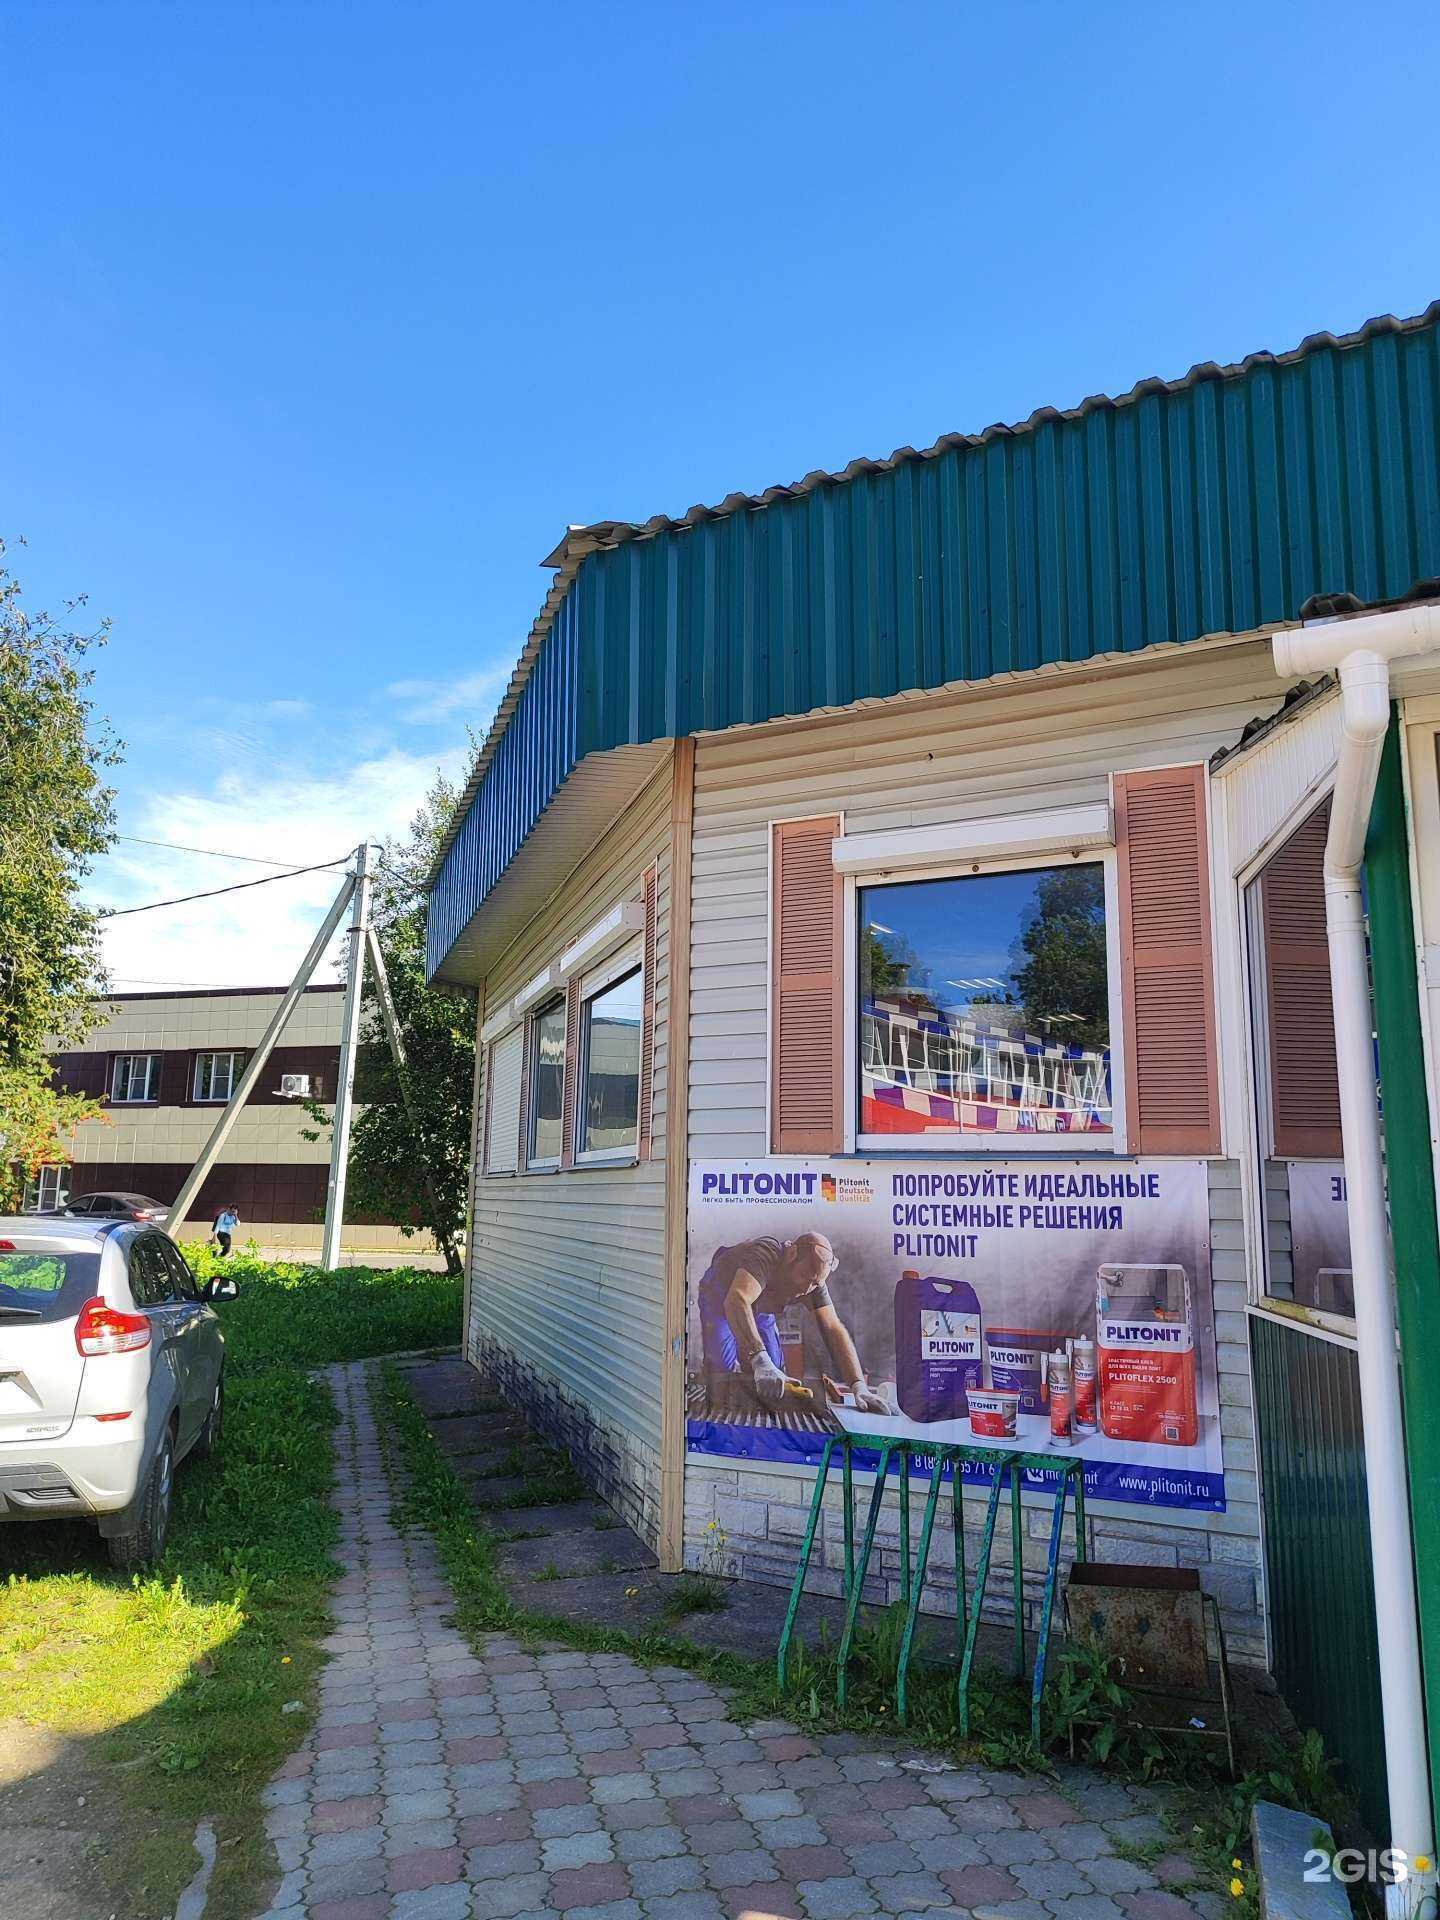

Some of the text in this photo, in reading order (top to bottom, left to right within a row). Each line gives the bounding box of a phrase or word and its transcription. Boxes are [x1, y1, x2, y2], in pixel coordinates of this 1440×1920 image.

[702, 1173, 817, 1195] PLITONIT
[839, 1178, 870, 1186] Plitonit
[892, 1169, 1160, 1201] ПОПРОБУЙТЕ ИДЕАЛЬНЫЕ
[892, 1203, 1123, 1229] СИСТЕМНЫЕ РЕШЕНИЯ
[893, 1234, 978, 1258] PLITONIT
[1107, 1326, 1181, 1342] PLITONIT
[929, 1341, 975, 1354] PLITONIT
[990, 1351, 1034, 1364] PLITONIT
[1108, 1373, 1177, 1385] PLITOFLEX 2500
[1119, 1475, 1209, 1497] www.plitonit.ru
